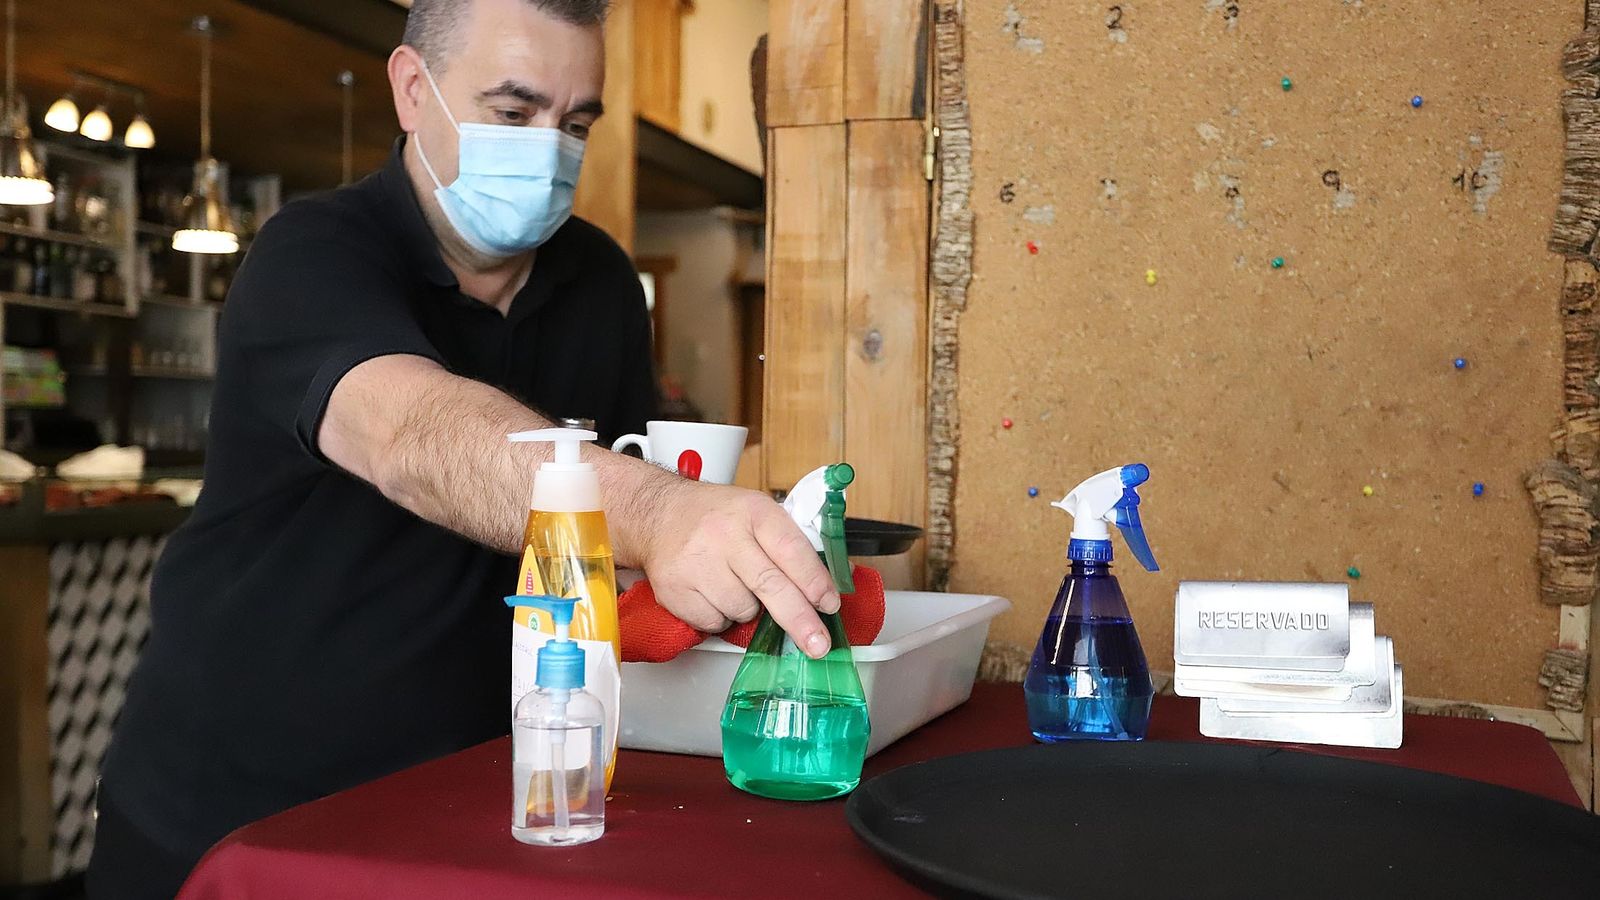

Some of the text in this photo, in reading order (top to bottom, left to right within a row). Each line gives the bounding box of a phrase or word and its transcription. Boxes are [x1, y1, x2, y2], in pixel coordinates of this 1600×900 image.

[1107, 5, 1122, 29] 2
[1322, 169, 1340, 191] 9
[1000, 182, 1015, 203] 6
[1198, 610, 1330, 630] RESERVADO
